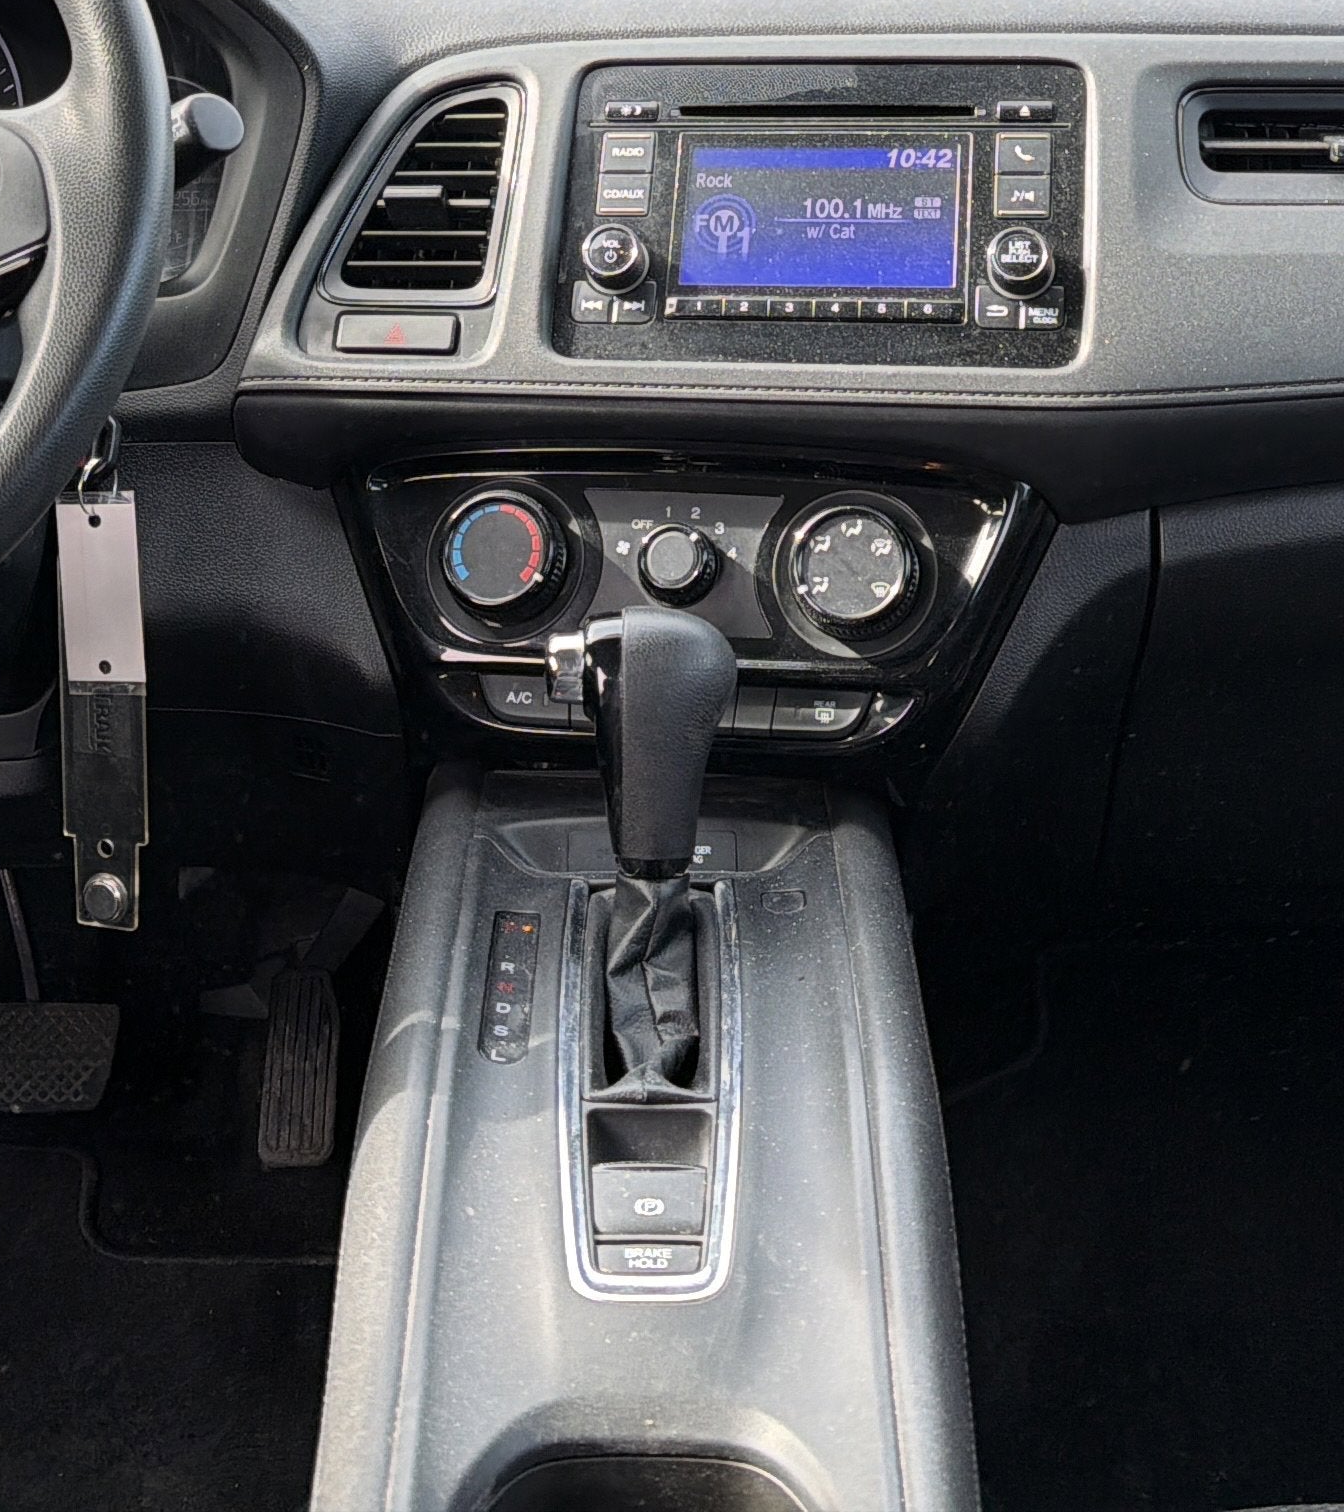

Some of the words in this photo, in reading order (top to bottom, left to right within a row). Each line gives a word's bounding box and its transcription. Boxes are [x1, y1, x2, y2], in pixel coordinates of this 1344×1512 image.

[611, 146, 645, 157] RADIO
[885, 148, 953, 169] 10:42
[695, 172, 733, 188] Rock
[602, 188, 645, 200] CD/AUX
[802, 198, 863, 220] 100.1
[867, 202, 903, 220] MHz
[829, 223, 856, 239] Cat
[602, 239, 622, 249] VOL
[1008, 239, 1032, 248] LIST
[1000, 254, 1039, 264] SELECT
[695, 301, 702, 311] 1
[739, 301, 749, 312] 2
[784, 302, 794, 313] 3
[830, 303, 840, 313] 4
[877, 303, 887, 314] 5
[923, 303, 933, 315] 6
[1028, 307, 1059, 317] MENU
[665, 506, 672, 518] 1
[690, 506, 702, 519] 2
[631, 518, 654, 530] OFF
[714, 521, 725, 535] 3
[726, 546, 738, 560] 4
[505, 690, 534, 704] A/C
[500, 961, 516, 975] R
[495, 1002, 512, 1014] D
[492, 1024, 509, 1037] S
[490, 1048, 507, 1062] L
[624, 1247, 673, 1259] BRAKE
[628, 1258, 669, 1269] HOLD
